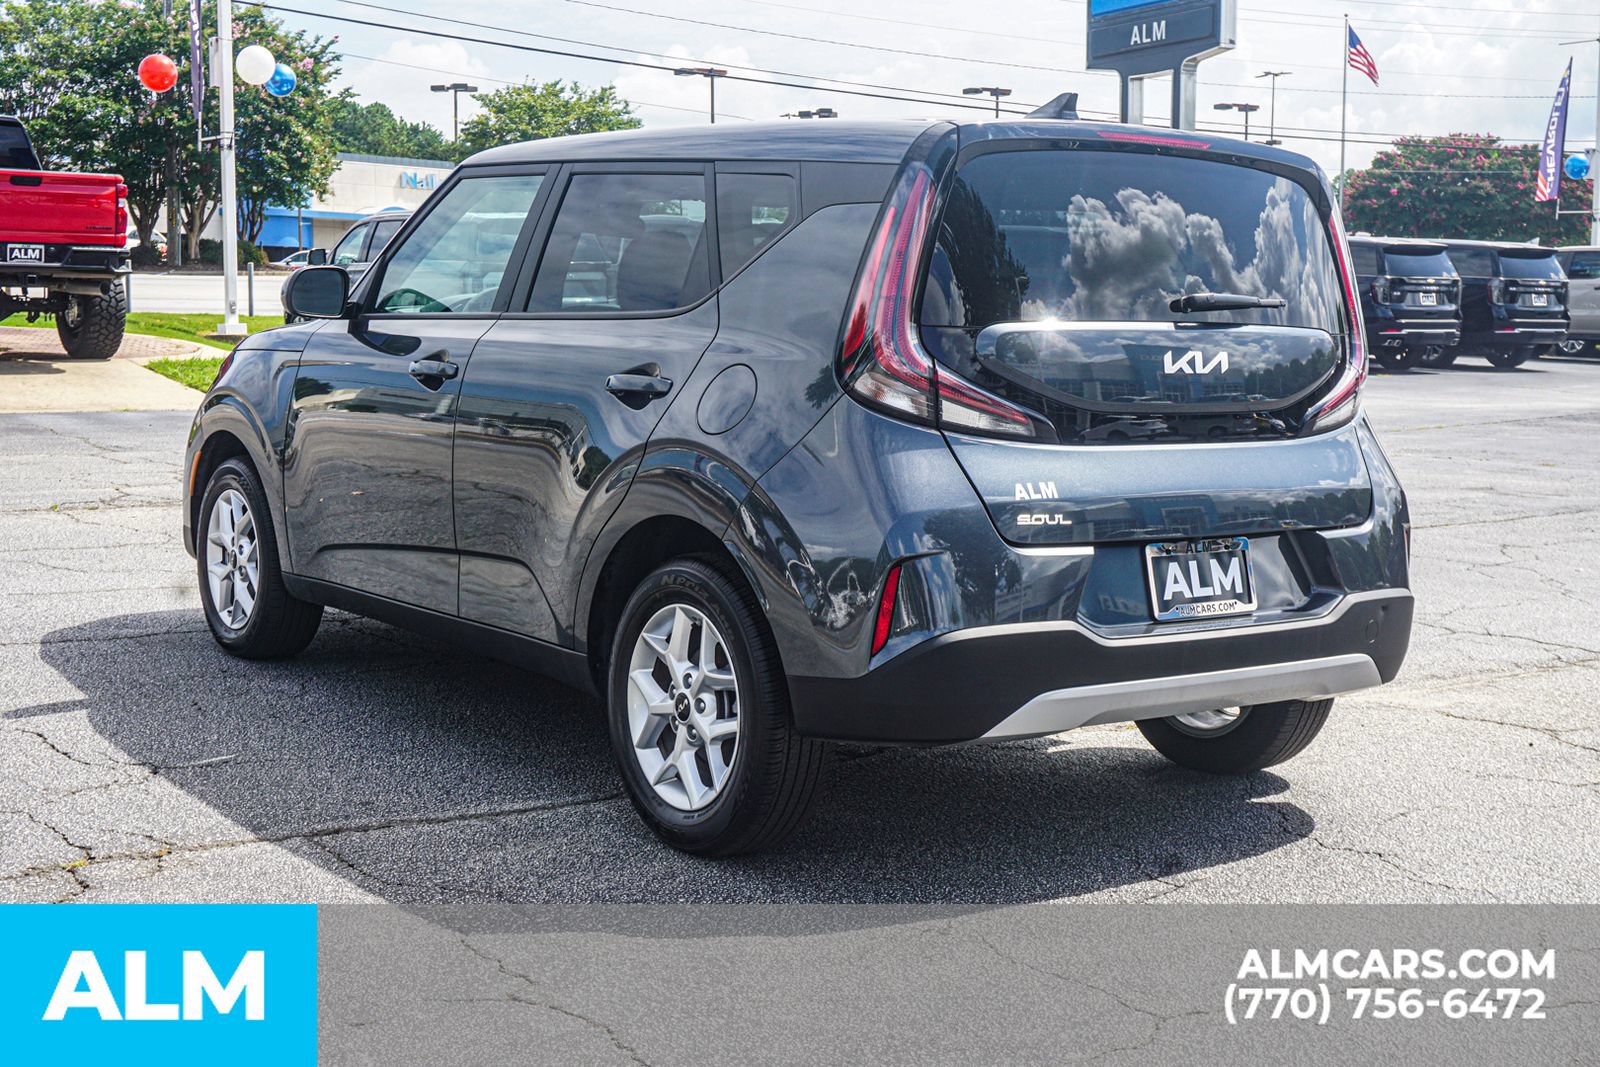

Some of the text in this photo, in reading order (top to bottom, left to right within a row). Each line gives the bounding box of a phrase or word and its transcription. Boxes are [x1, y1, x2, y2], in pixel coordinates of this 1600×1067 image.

[1130, 20, 1166, 45] ALM
[11, 248, 40, 259] ALM
[1164, 350, 1229, 374] KIA
[1015, 481, 1059, 501] ALM
[1017, 513, 1073, 526] SOUL
[1186, 540, 1213, 554] ALM
[1163, 557, 1244, 601] ALM
[1180, 602, 1236, 616] ALMCARS.COM
